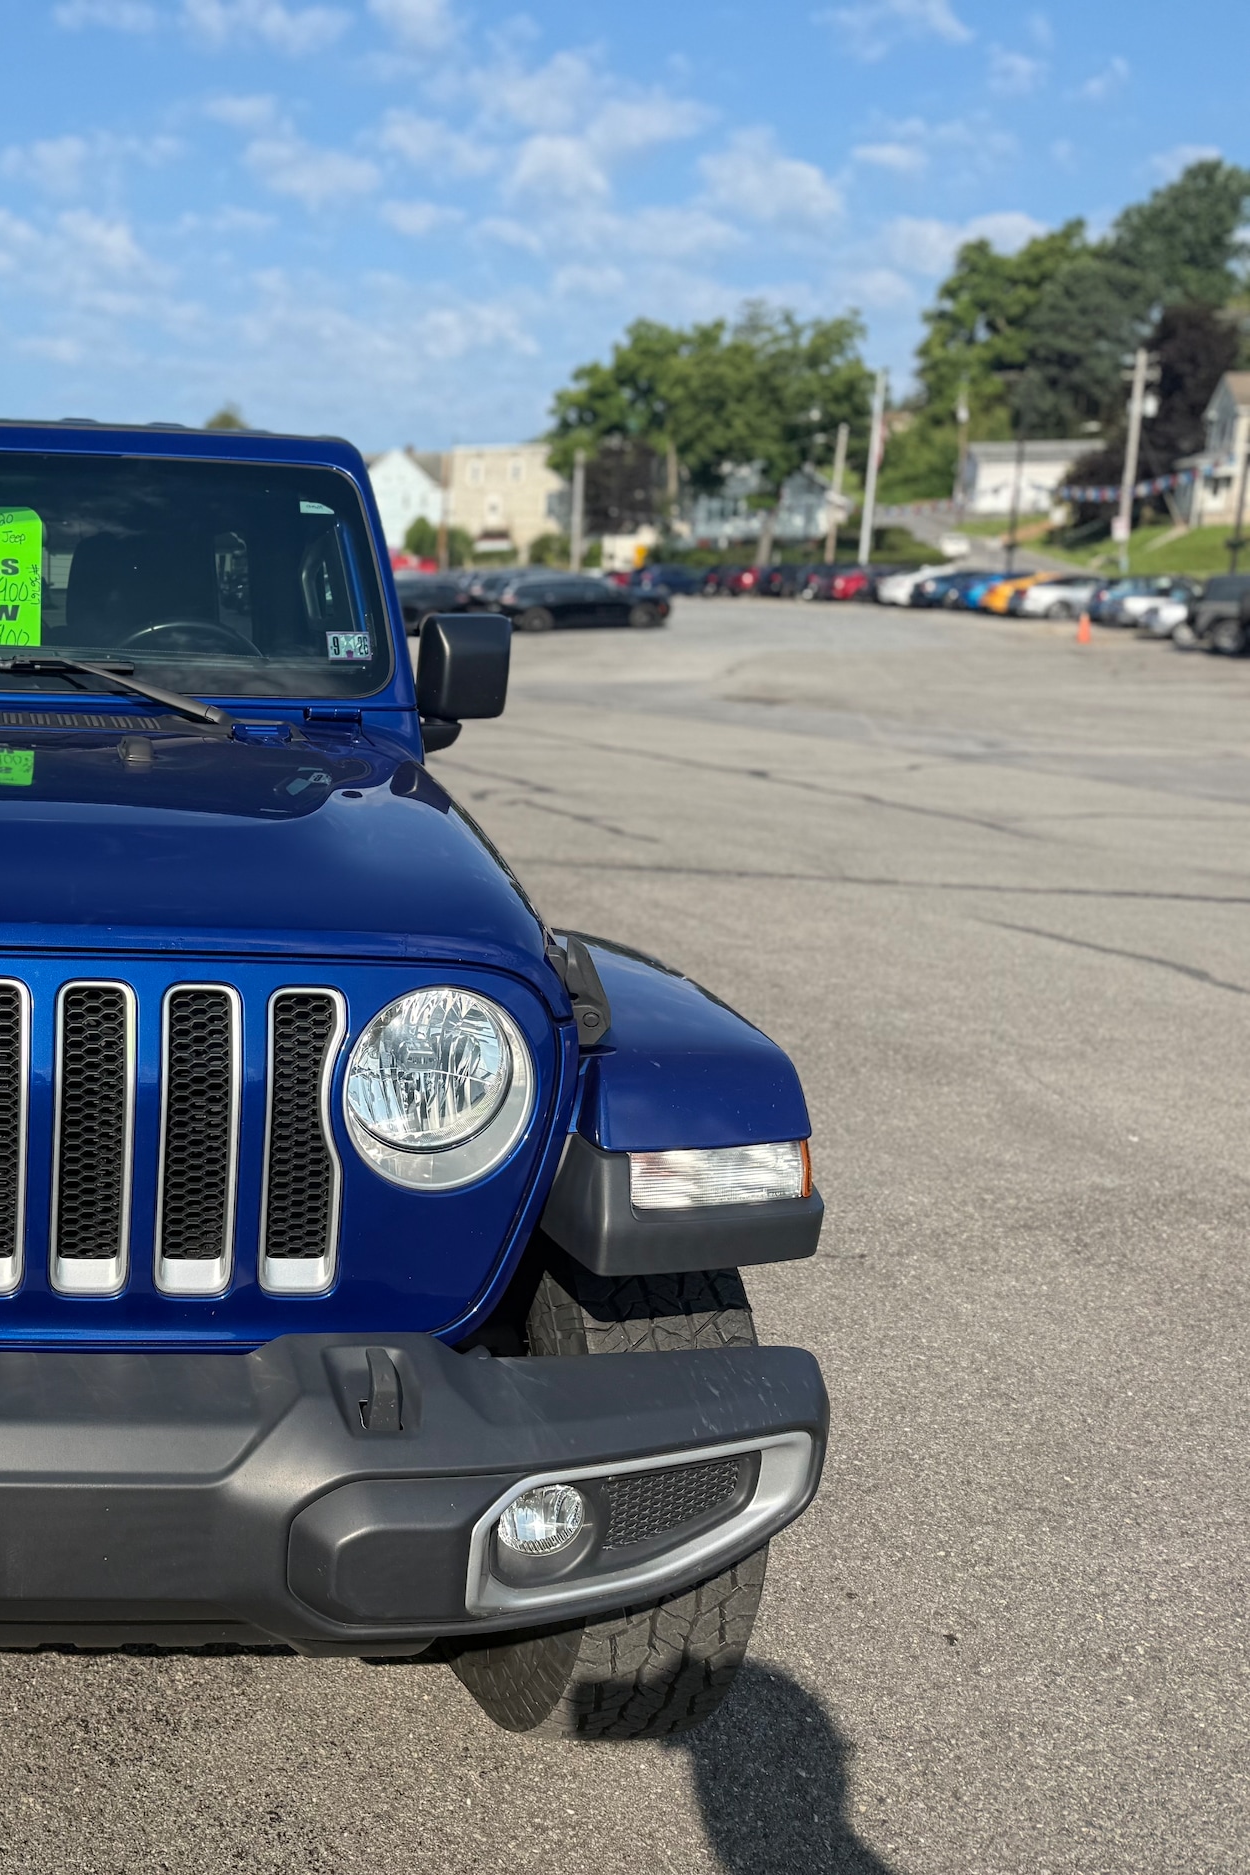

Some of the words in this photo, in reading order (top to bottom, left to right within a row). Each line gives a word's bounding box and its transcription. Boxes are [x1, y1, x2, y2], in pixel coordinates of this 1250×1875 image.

[1, 530, 26, 545] Jeep
[333, 636, 340, 656] 9
[358, 636, 369, 655] 26
